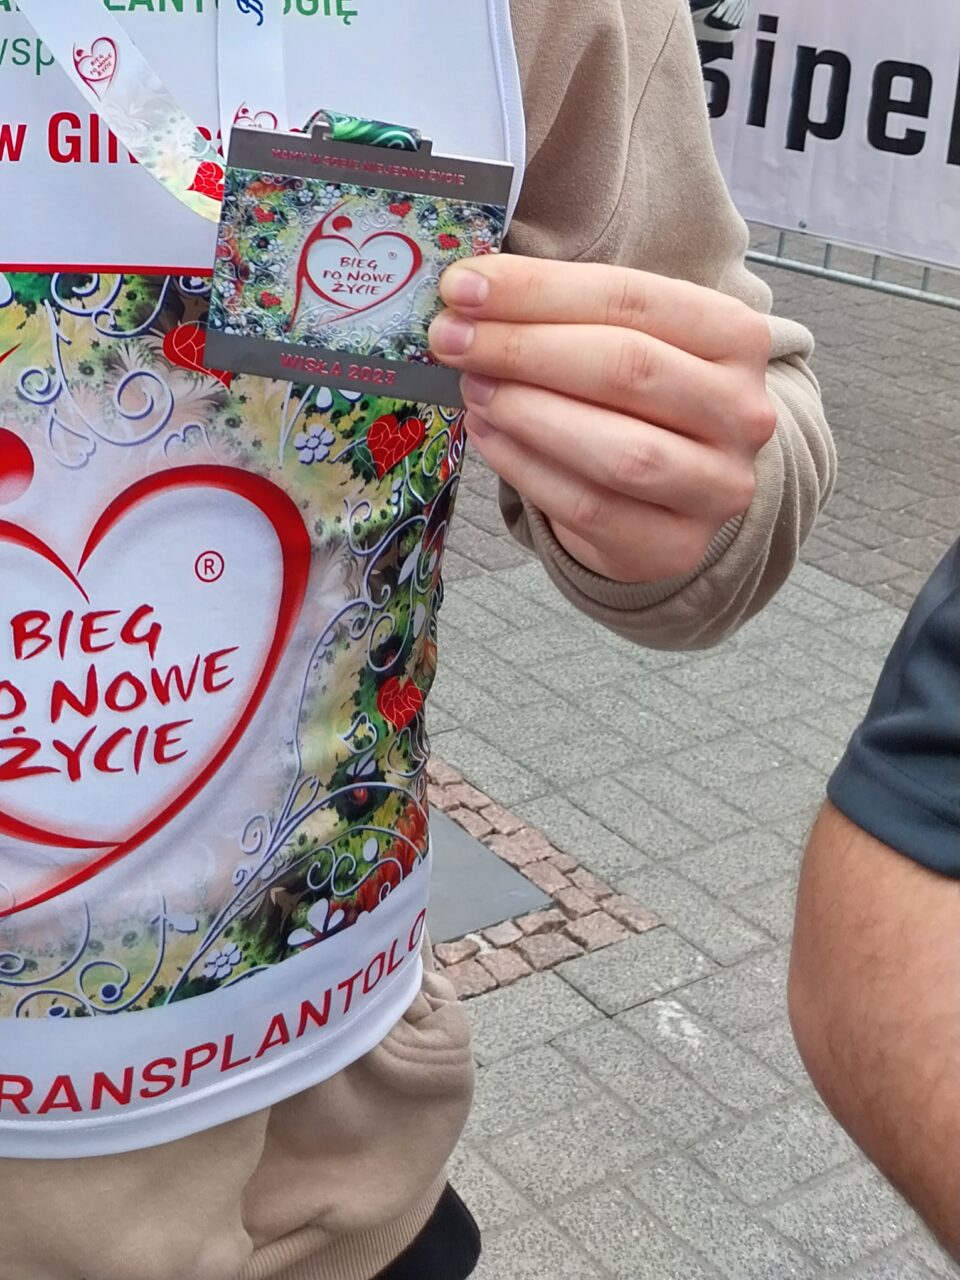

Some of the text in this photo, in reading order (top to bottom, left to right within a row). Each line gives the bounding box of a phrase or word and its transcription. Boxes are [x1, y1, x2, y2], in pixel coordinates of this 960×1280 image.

[340, 256, 378, 271] BIEG
[323, 270, 397, 283] PO NOWE
[280, 352, 344, 377] WISŁA
[10, 603, 162, 661] BIEG
[50, 646, 240, 724] NOWE
